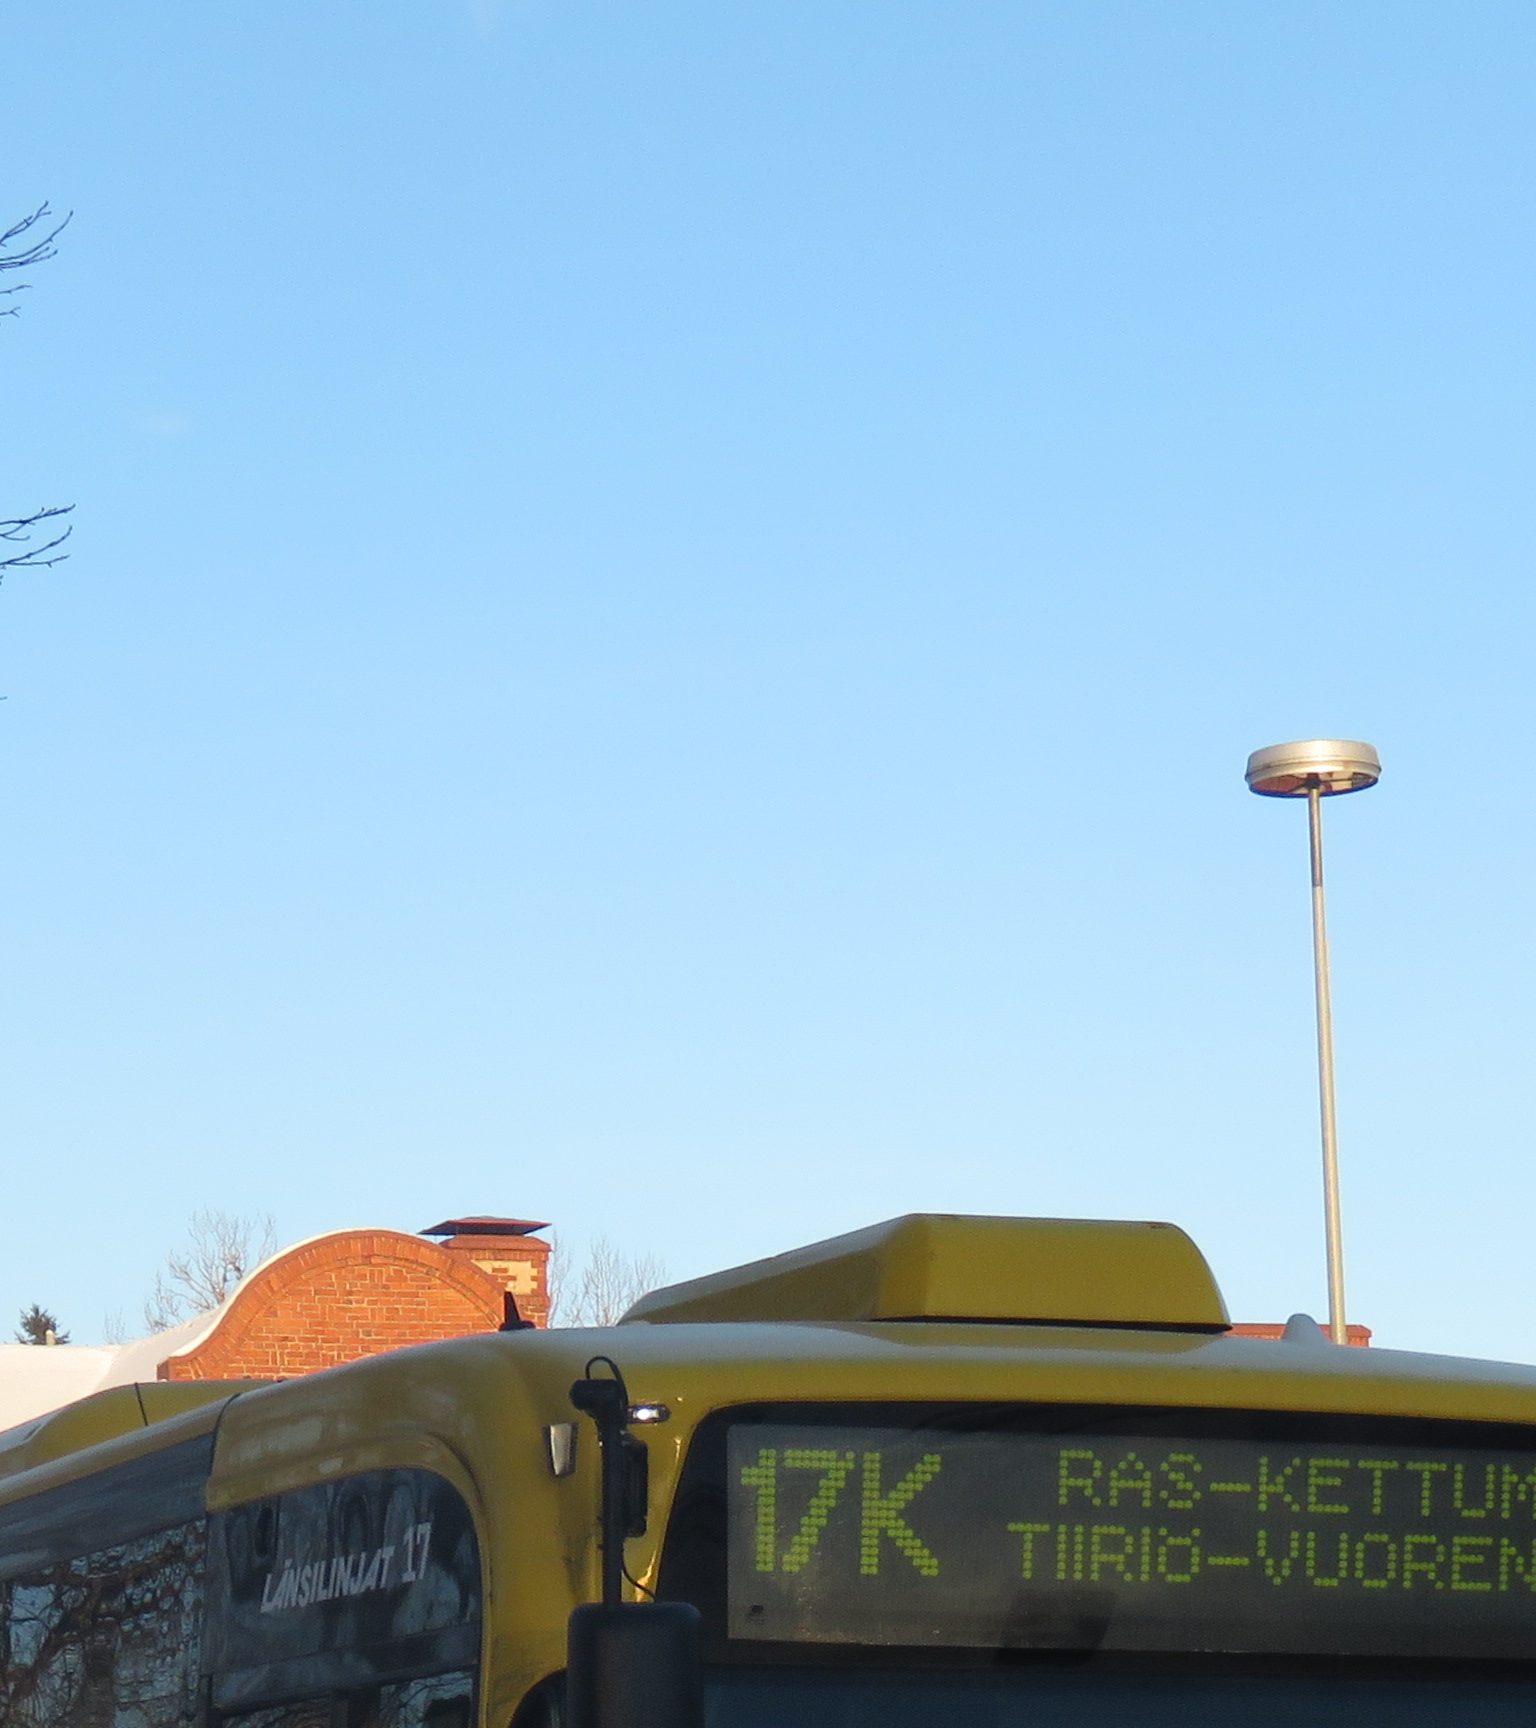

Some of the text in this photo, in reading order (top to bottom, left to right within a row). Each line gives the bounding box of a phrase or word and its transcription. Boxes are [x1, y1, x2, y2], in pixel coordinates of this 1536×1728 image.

[261, 1521, 432, 1613] LÄNSILINJAT 17
[740, 1448, 942, 1576] 17K
